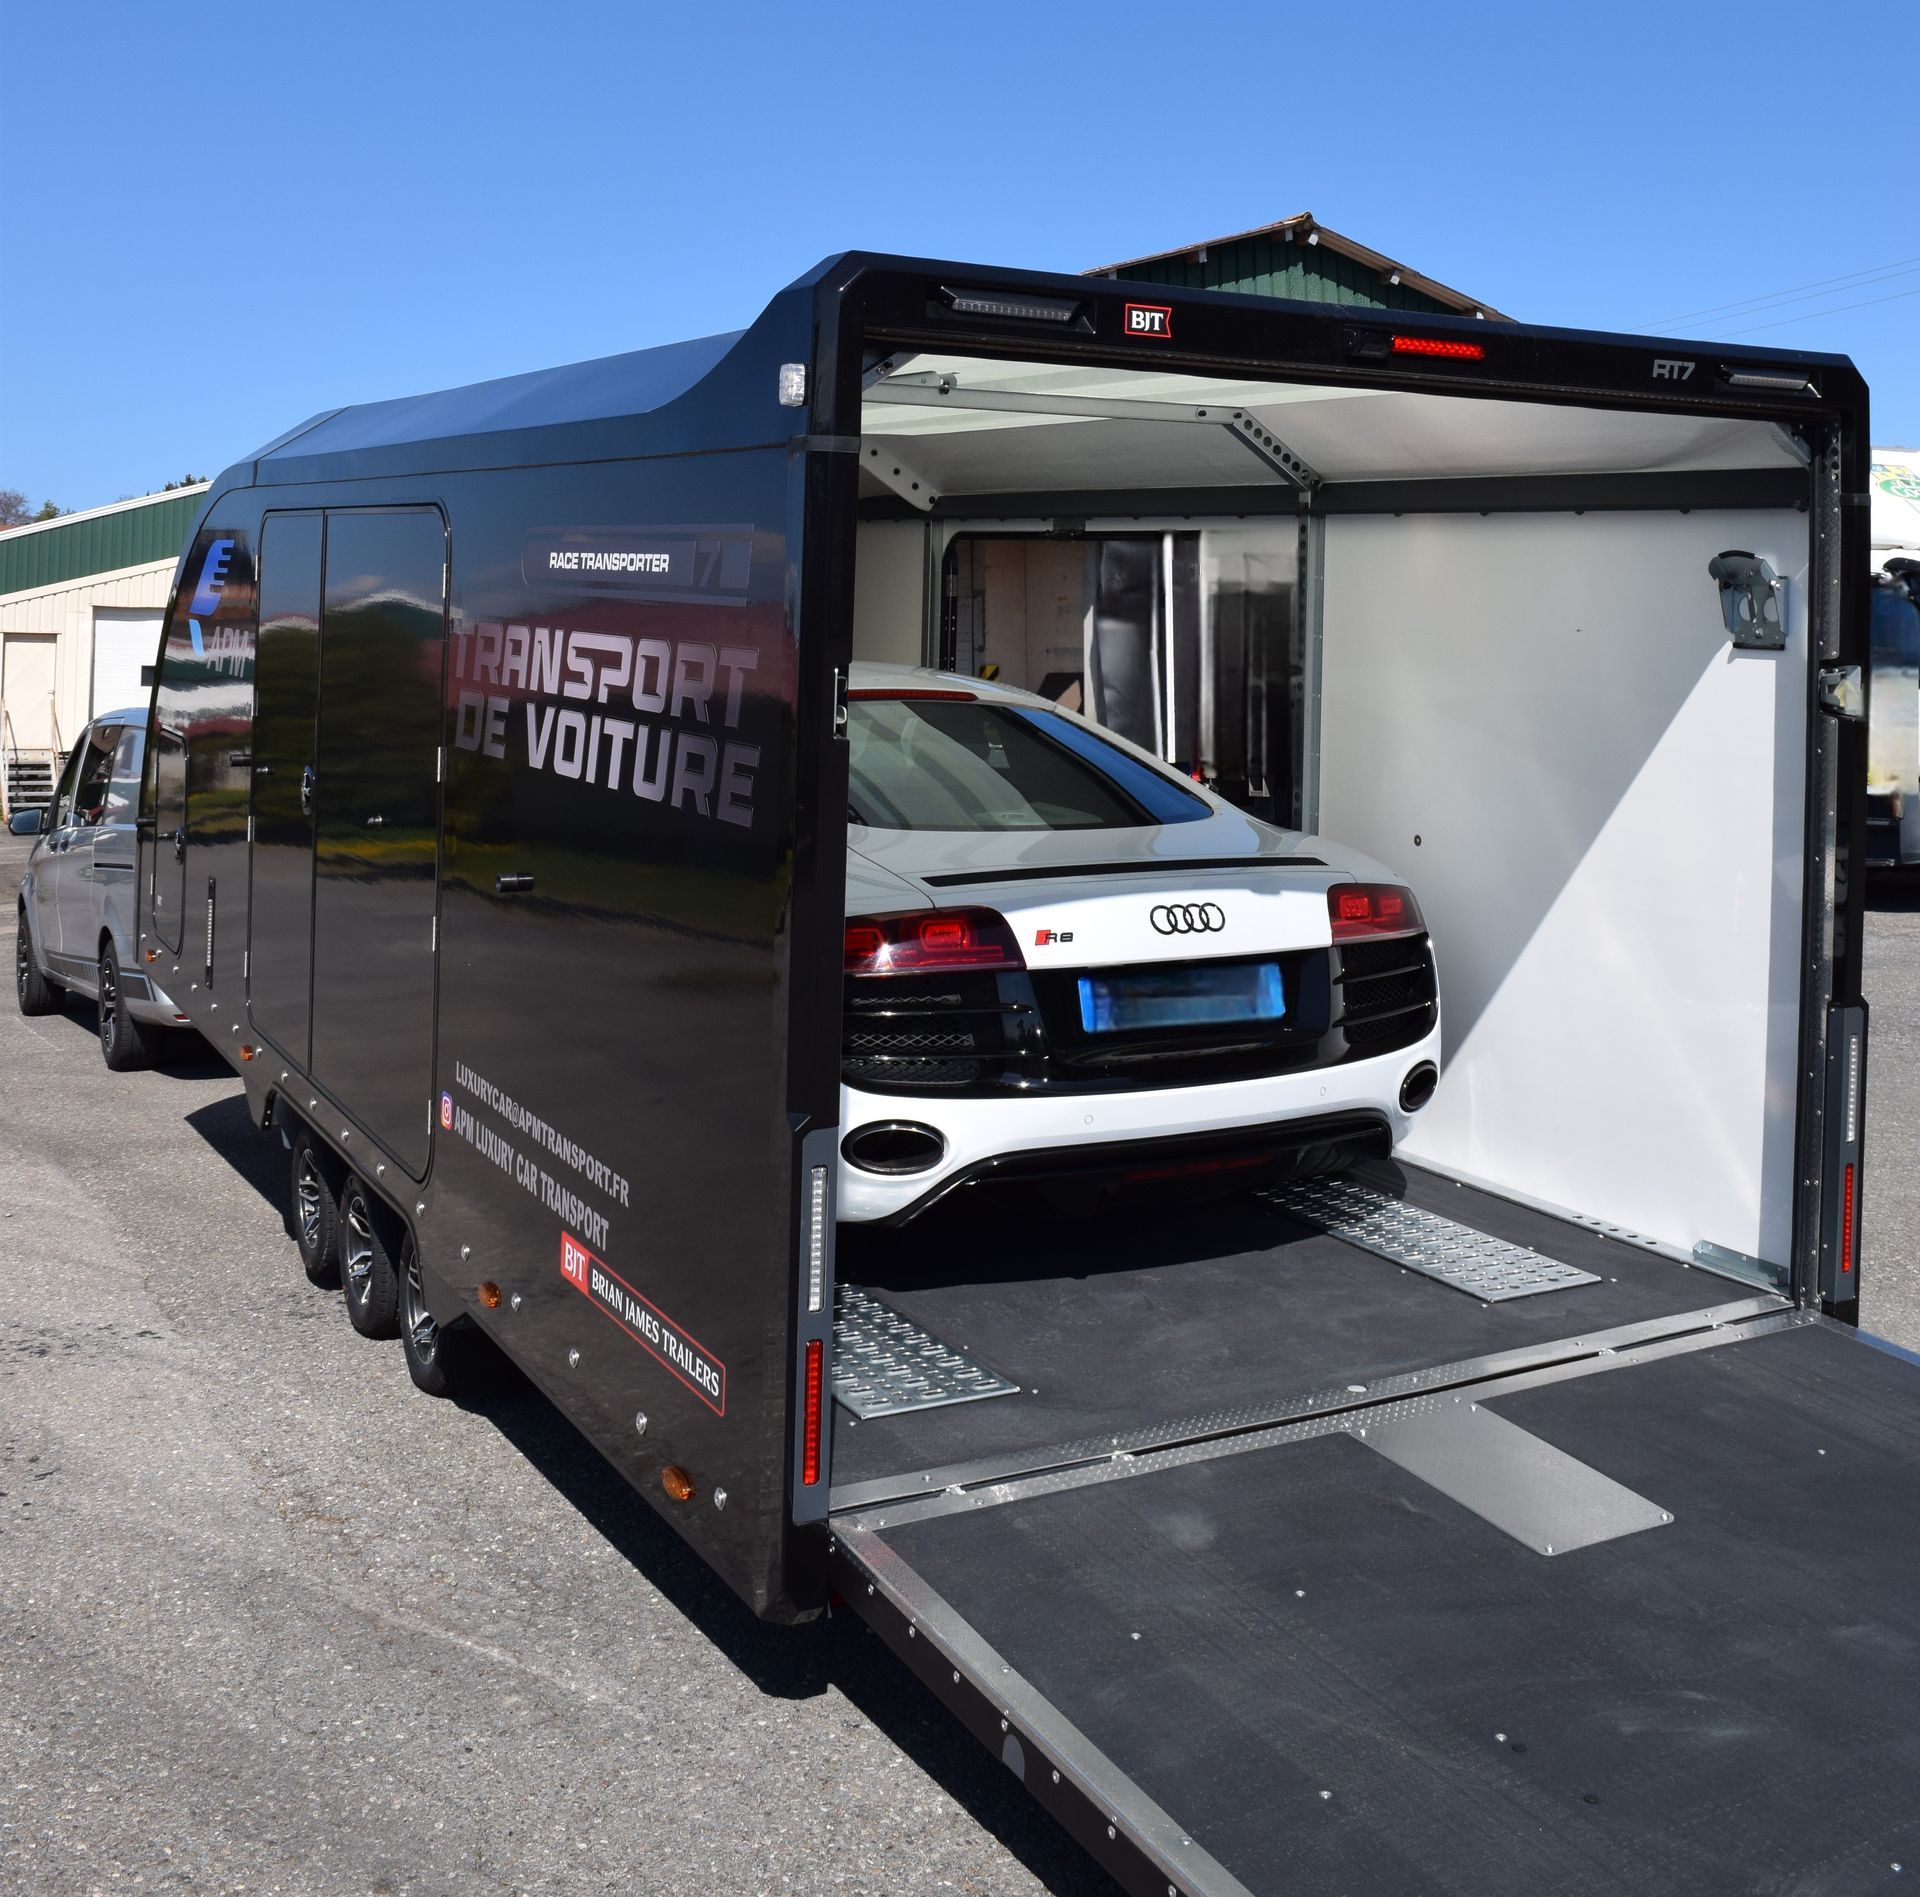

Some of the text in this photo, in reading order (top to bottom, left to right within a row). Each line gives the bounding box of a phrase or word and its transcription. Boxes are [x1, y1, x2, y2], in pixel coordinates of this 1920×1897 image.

[1131, 310, 1164, 331] BJT
[1652, 359, 1696, 380] RT7
[549, 552, 579, 570] RACE
[580, 552, 670, 573] TRANSPORTER
[206, 626, 249, 678] APM
[452, 621, 760, 730] TRANSPORT
[454, 688, 761, 828] DE VOITURE
[1044, 932, 1074, 943] R8
[456, 1061, 630, 1208] LUXURYCAR@APMTRANSPORT.FR
[454, 1105, 609, 1251] APM LUXURY CAR TRANSPORT
[564, 1242, 720, 1397] BJT BRIAN JAMES TRAILERS
